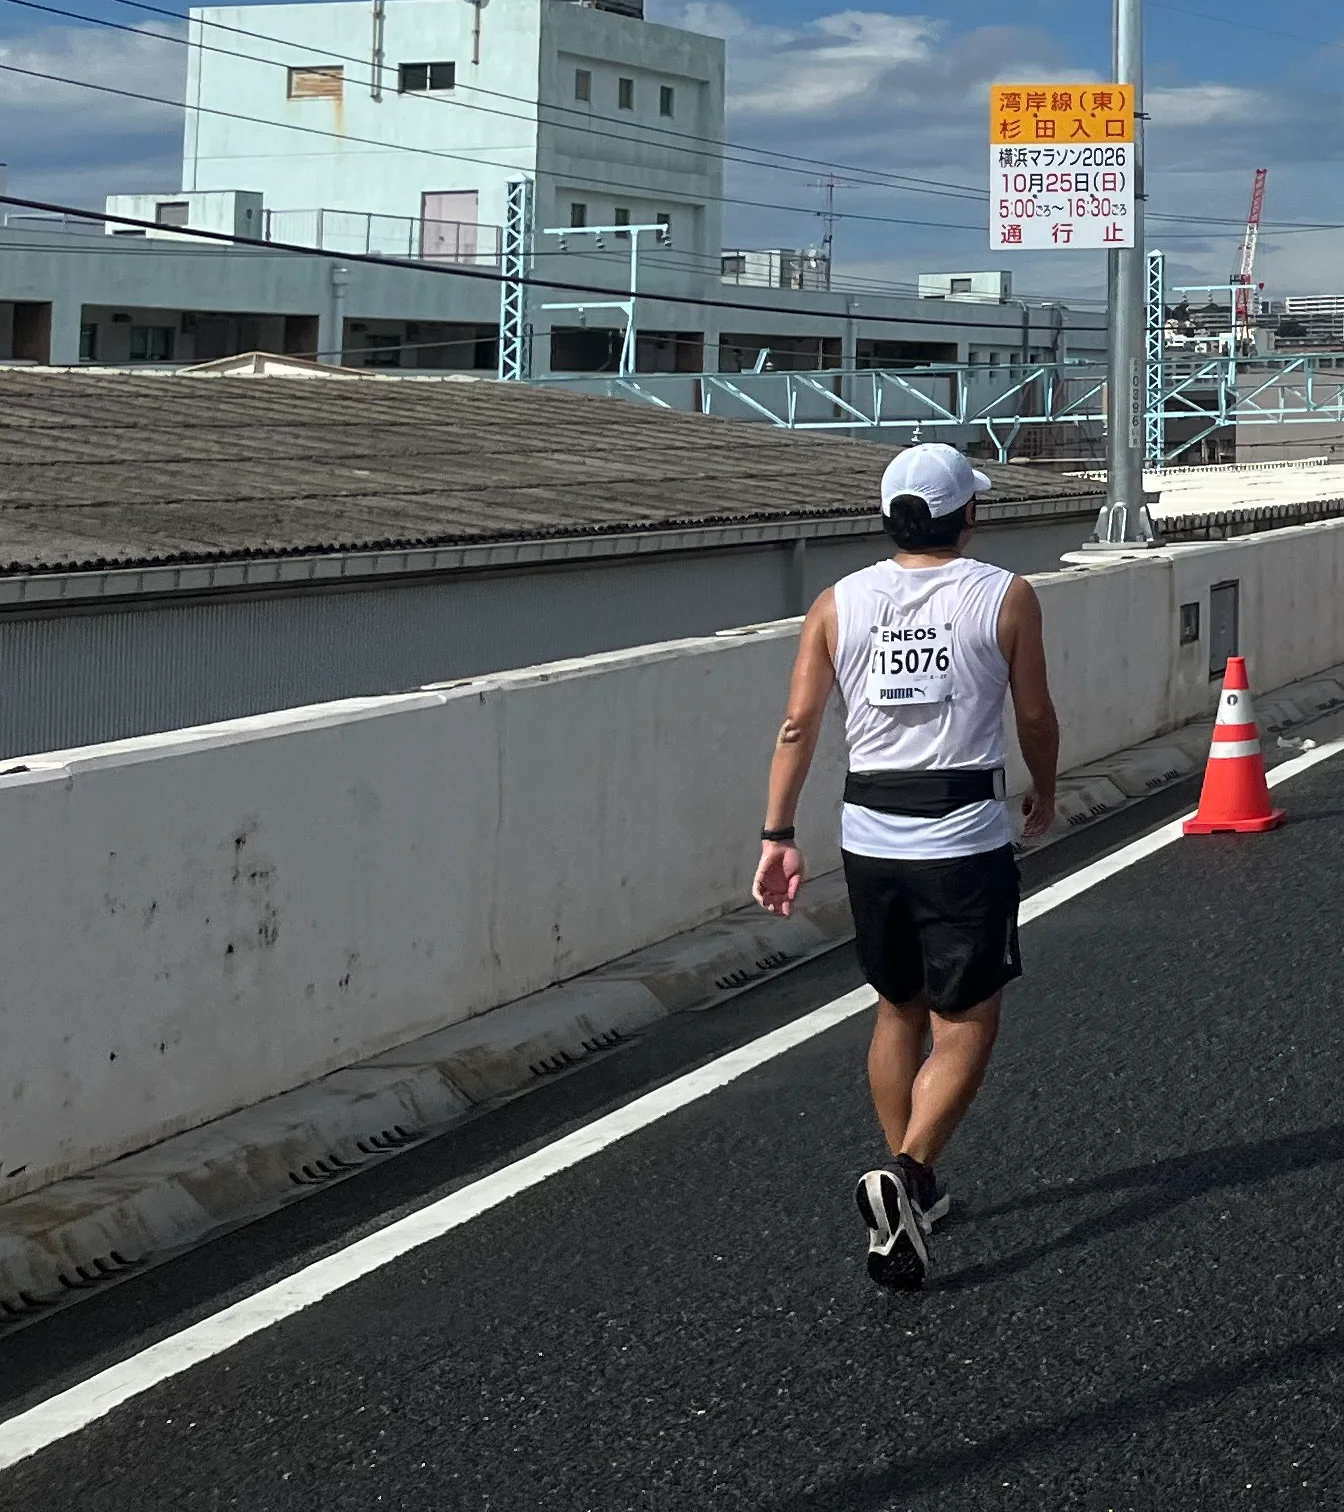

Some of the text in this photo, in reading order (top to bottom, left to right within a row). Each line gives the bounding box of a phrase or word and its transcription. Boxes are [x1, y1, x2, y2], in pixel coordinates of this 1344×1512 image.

[999, 119, 1125, 139] 杉田入口
[998, 147, 1126, 168] 横浜マラソン2026
[1000, 222, 1125, 244] 通行止
[882, 627, 937, 642] ENEOS
[880, 688, 913, 699] PUMA
